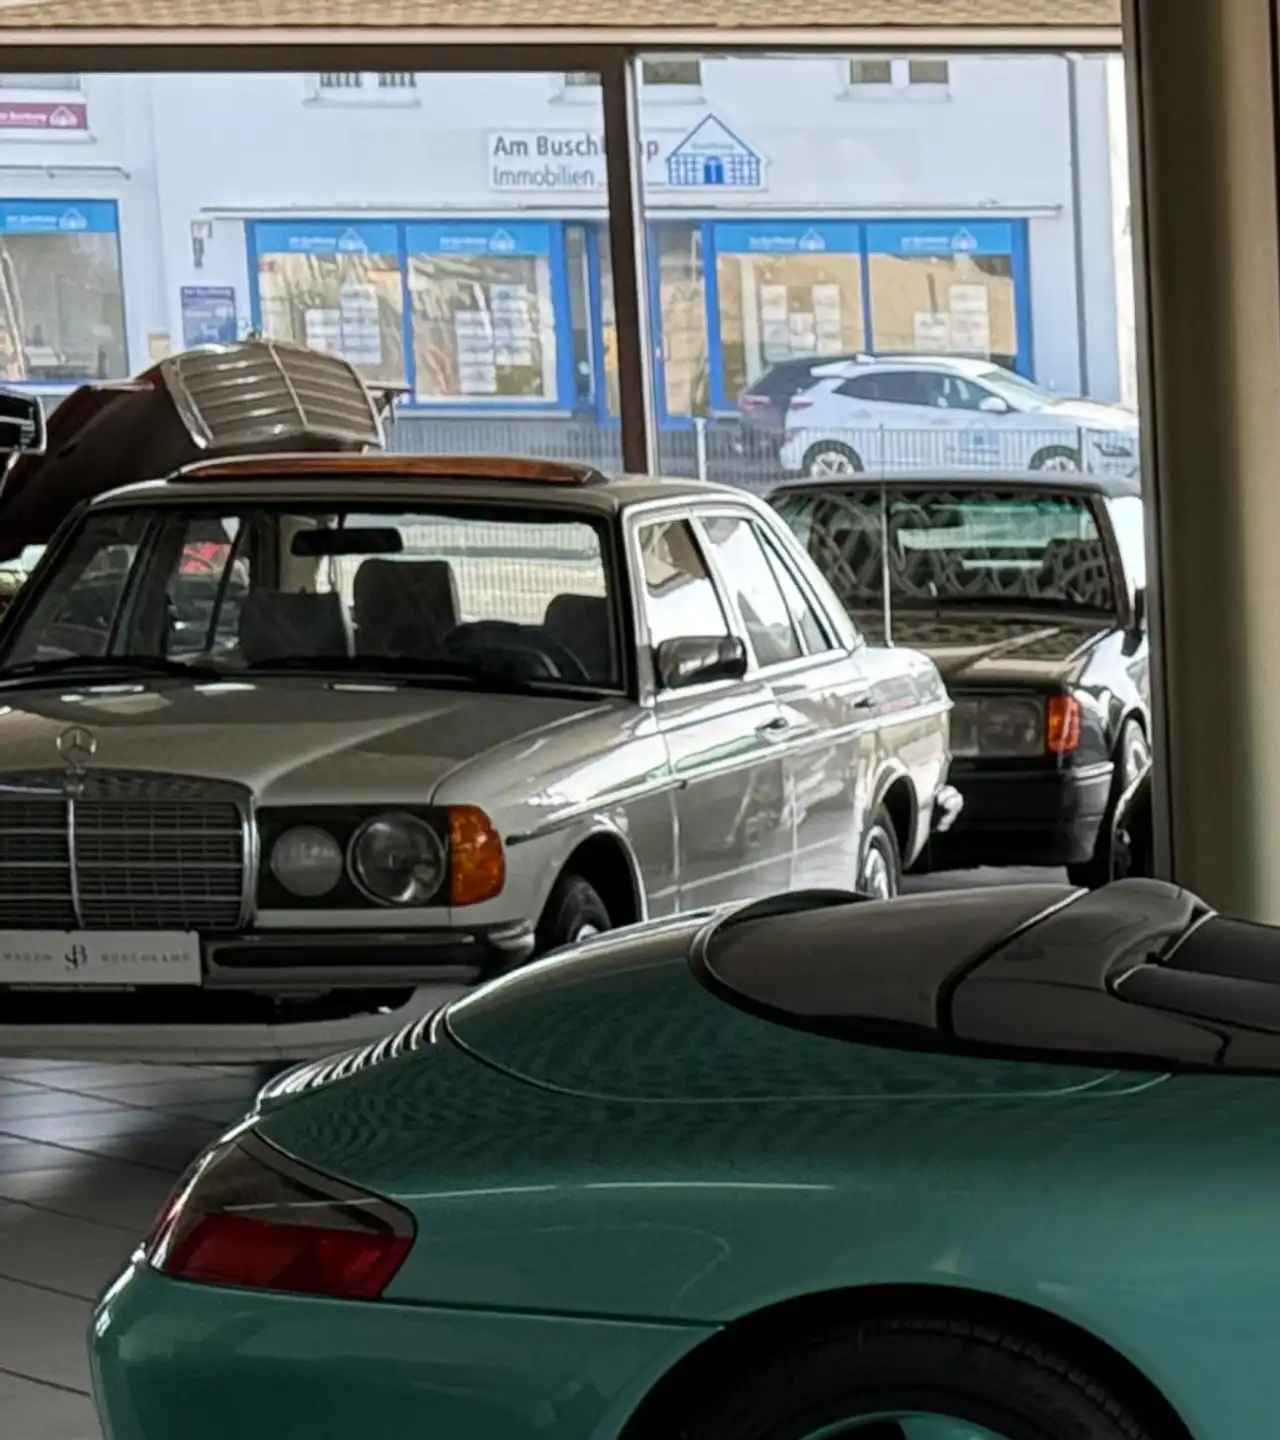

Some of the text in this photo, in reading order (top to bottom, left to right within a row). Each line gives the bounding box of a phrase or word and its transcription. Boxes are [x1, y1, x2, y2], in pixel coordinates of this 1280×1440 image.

[493, 135, 659, 161] Am Buschp
[492, 164, 595, 187] Immobilien
